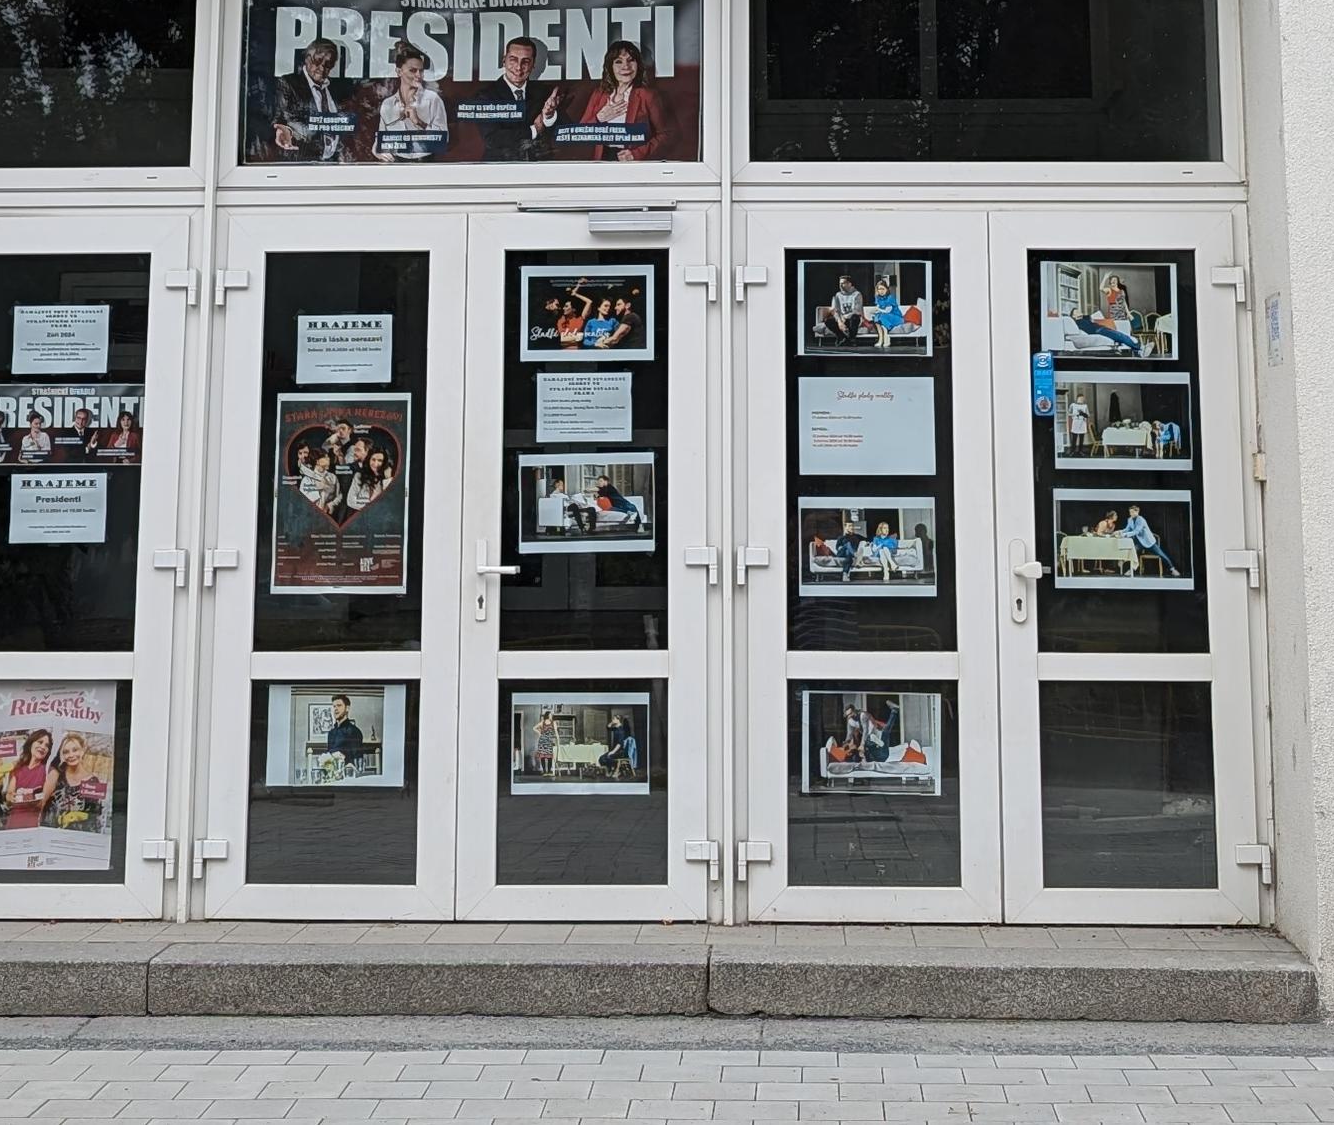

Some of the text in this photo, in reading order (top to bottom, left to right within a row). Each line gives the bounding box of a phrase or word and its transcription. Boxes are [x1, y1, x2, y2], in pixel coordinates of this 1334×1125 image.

[274, 5, 675, 82] PRESIDENTI
[307, 321, 383, 330] HRAJEME
[20, 479, 97, 488] HRAJEME
[35, 495, 82, 503] Presidenti
[10, 690, 86, 717] Růžové
[56, 707, 104, 724] svatby
